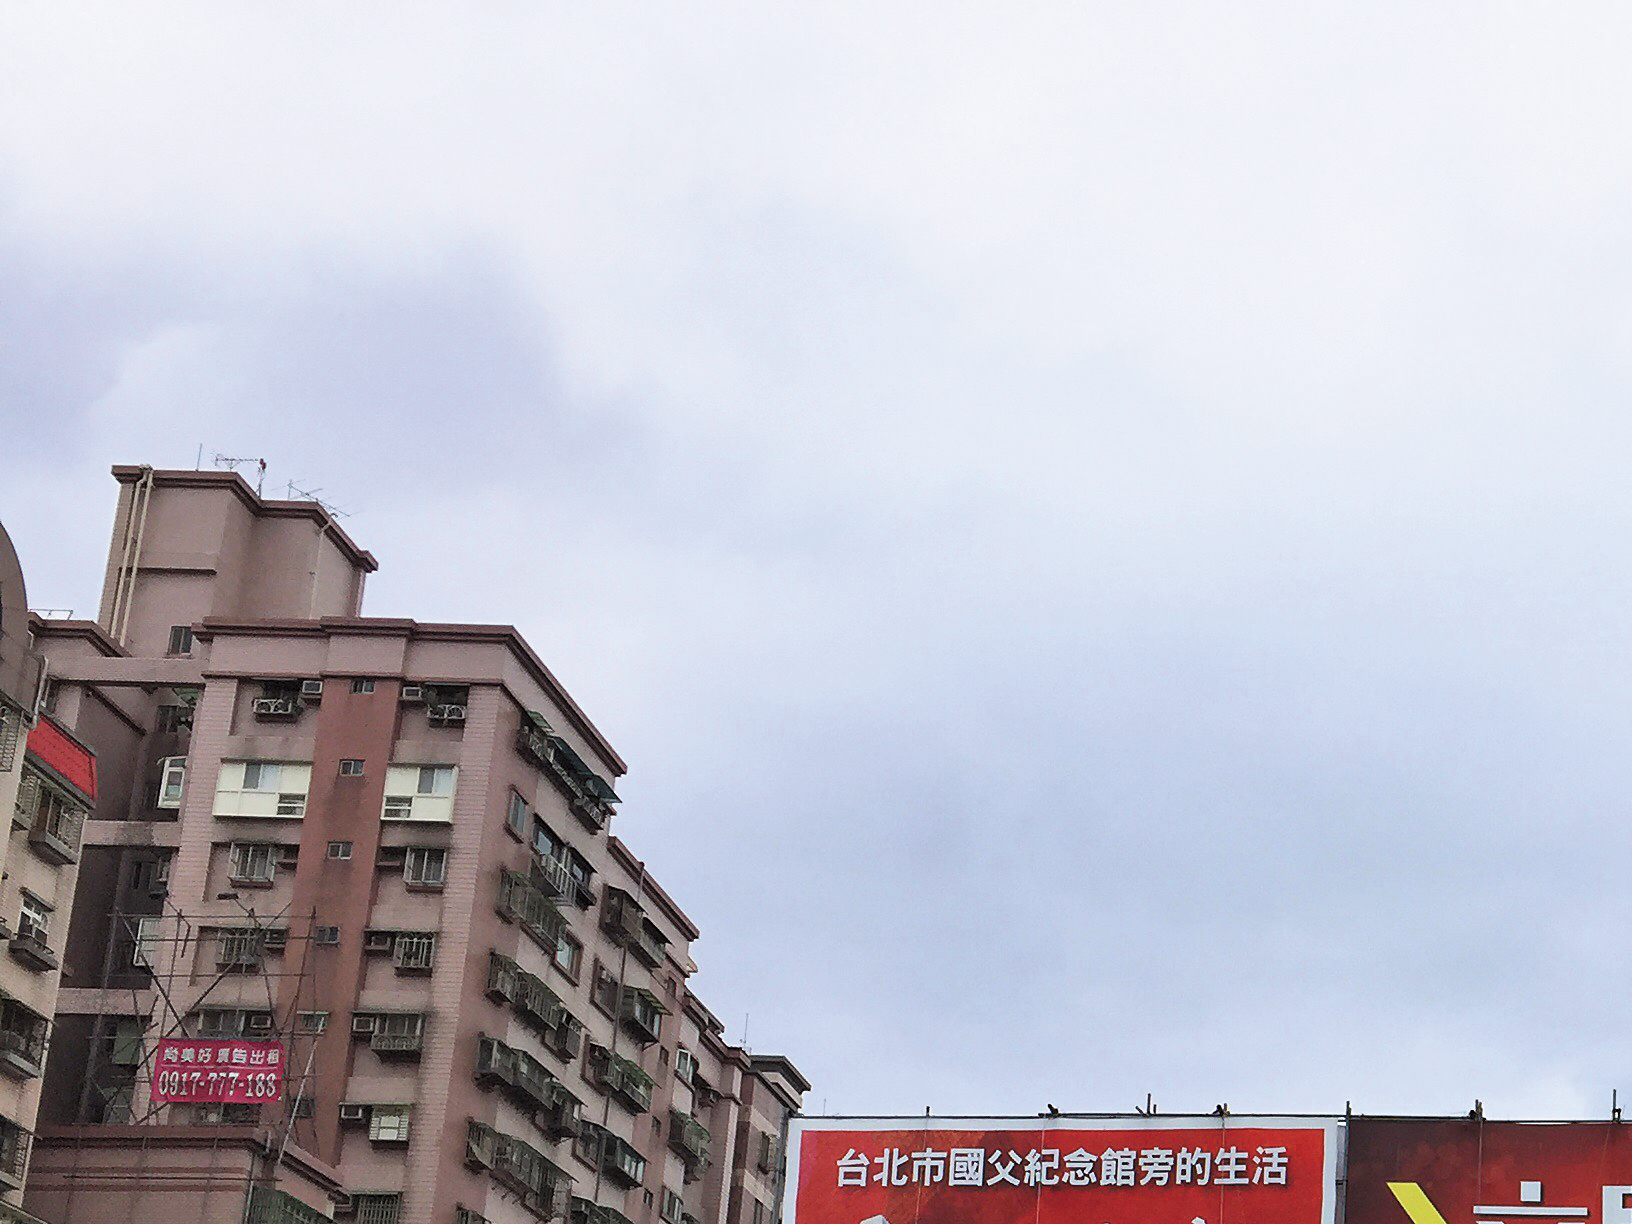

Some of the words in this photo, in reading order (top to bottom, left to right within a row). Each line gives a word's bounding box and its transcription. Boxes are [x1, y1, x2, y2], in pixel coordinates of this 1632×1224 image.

[836, 1146, 1289, 1187] 台北市國父紀念館旁的生活
